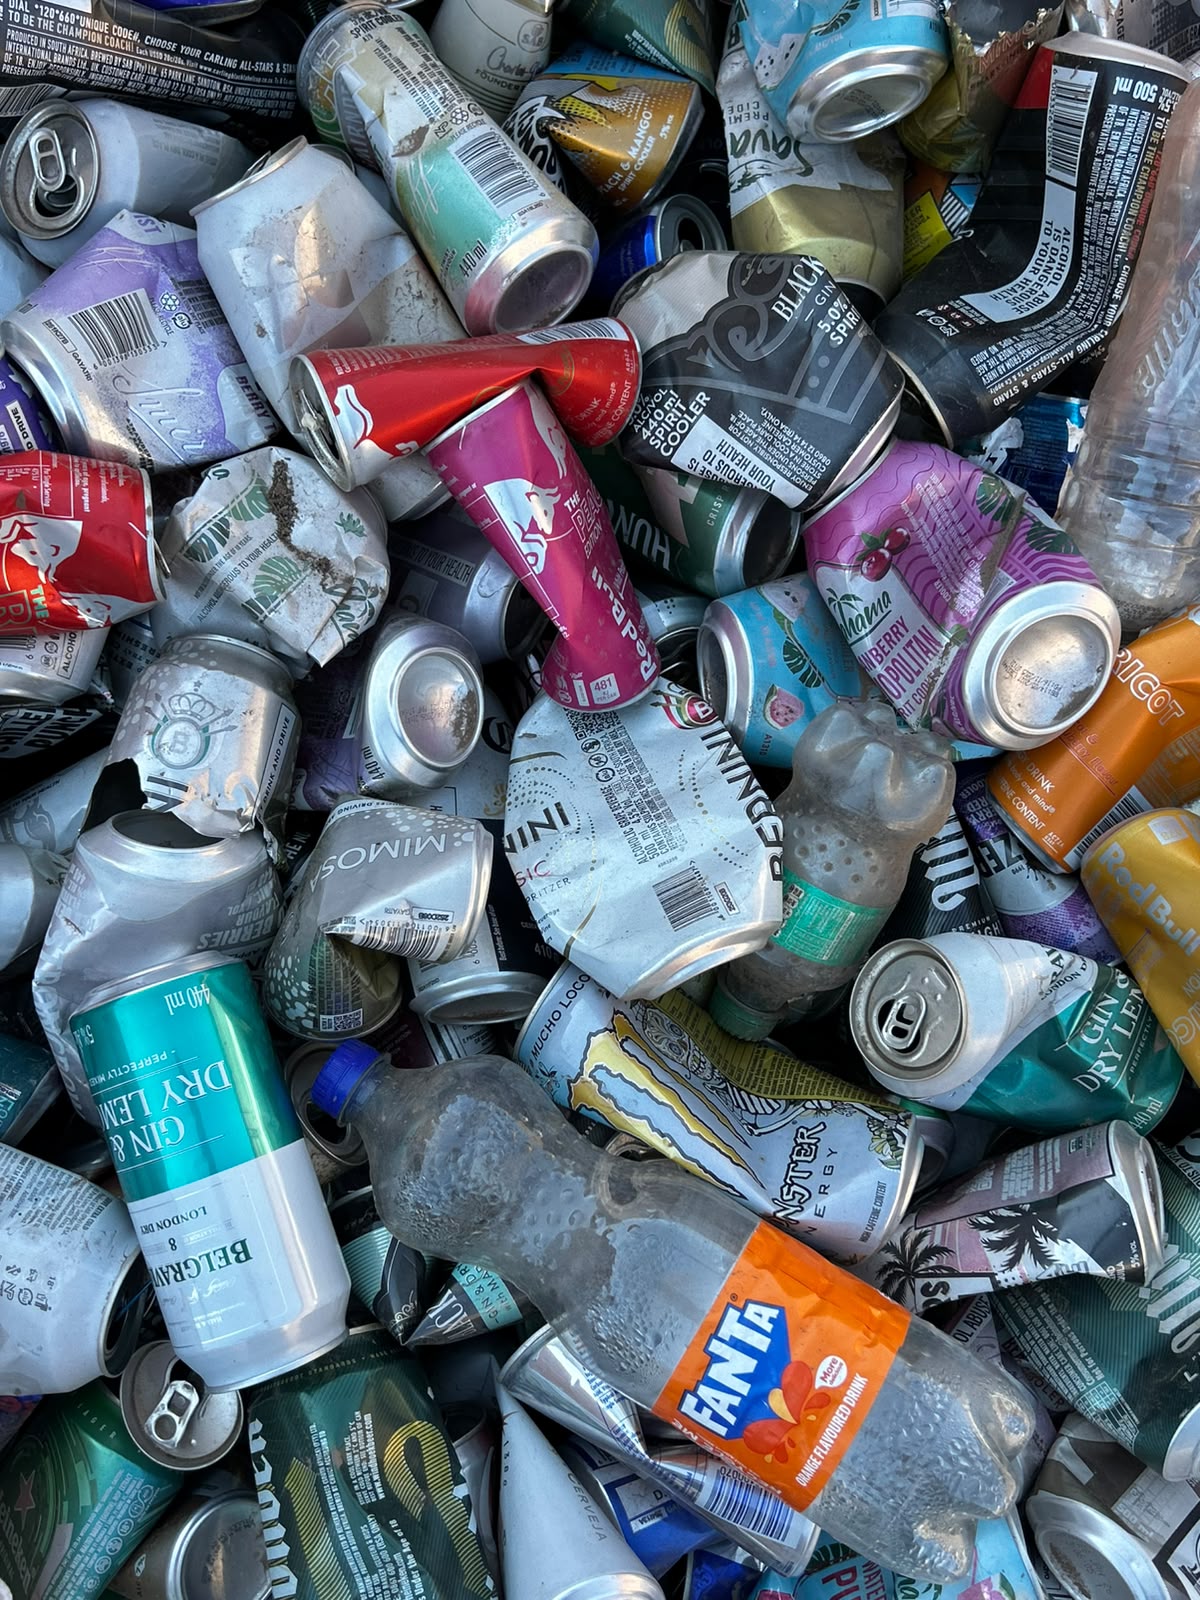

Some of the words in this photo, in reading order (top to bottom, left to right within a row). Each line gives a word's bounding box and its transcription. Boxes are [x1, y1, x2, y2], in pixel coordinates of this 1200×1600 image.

[7, 29, 38, 46] PRODUCED
[8, 10, 20, 22] TO
[23, 13, 35, 26] BE
[37, 17, 54, 32] THE
[57, 23, 102, 44] CHAMPION
[104, 36, 134, 52] COACH!
[350, 20, 378, 39] SPIRIT
[5, 41, 52, 61] INTERNATIONAL
[144, 35, 178, 52] CHOOSE
[180, 45, 202, 58] YOUR
[203, 52, 238, 69] CARLING
[240, 60, 274, 73] ALL-STARS
[1112, 76, 1133, 95] ml
[1132, 80, 1158, 103] 500
[728, 100, 760, 112] CIDE
[728, 110, 770, 126] PREMI
[627, 110, 653, 159] MANGO
[1115, 107, 1141, 157] INTERNATIONAL
[1132, 110, 1151, 145] PRODUCED
[1150, 130, 1160, 144] BE
[1154, 116, 1166, 129] TO
[618, 171, 637, 192] SPIRIT
[634, 135, 656, 171] COOLER
[1144, 146, 1157, 165] THE
[1127, 166, 1151, 216] CHAMPION
[1043, 220, 1054, 237] TO
[1052, 229, 1062, 244] IS
[1116, 217, 1136, 252] COACH!
[459, 250, 477, 278] 440
[475, 238, 488, 260] ml
[1028, 241, 1051, 274] YOUR
[1051, 226, 1072, 287] ALCOHOL
[770, 255, 828, 323] BLACK
[990, 277, 1031, 302] HEALTH
[1004, 245, 1060, 307] DANGEROUS
[1111, 264, 1131, 301] CHOOSE
[814, 280, 837, 306] GIN
[1011, 291, 1051, 316] ABUSE
[816, 298, 849, 333] 5.0%
[1103, 303, 1119, 327] YOUR
[71, 351, 93, 382] GAYATRI
[1031, 349, 1075, 383] ALL-STARS
[235, 375, 270, 420] BERRY
[993, 385, 1020, 407] STAND
[1020, 379, 1030, 388] &
[611, 379, 632, 422] CONTENT
[633, 388, 668, 433] ALC/VOL
[641, 408, 665, 441] 440
[663, 389, 679, 412] ml
[10, 405, 30, 439] DRIVE
[649, 398, 687, 450] SPIRIT
[660, 391, 711, 457] COOLER
[728, 423, 741, 437] FOR
[734, 420, 746, 431] OF
[744, 428, 759, 440] AGE
[755, 425, 774, 441] DARK
[760, 418, 792, 447] CARELINE
[779, 421, 797, 438] (RSA
[715, 438, 752, 473] HEALTH
[739, 434, 757, 449] NOT
[755, 439, 769, 450] THE
[767, 448, 790, 466] UNDER
[772, 438, 790, 455] COOL
[687, 457, 700, 472] IS
[702, 448, 719, 467] TO
[790, 442, 827, 473] CUSTOMER
[799, 461, 822, 479] STORE
[813, 449, 832, 467] 0860
[749, 463, 777, 493] YOUR
[787, 463, 817, 486] PERSONS
[790, 474, 813, 491] ENJOY
[563, 489, 582, 513] THE
[570, 486, 603, 544] PEAC
[606, 499, 672, 571] HUN
[246, 547, 263, 564] YOUR
[443, 559, 474, 583] HEALTH
[30, 585, 49, 620] THE
[61, 630, 78, 673] ALCOHO
[620, 617, 658, 682] Red
[858, 615, 909, 673] NBERRY
[875, 624, 944, 702] OPOLITAN
[593, 677, 614, 692] 481
[1113, 647, 1186, 727] RICOT
[898, 699, 916, 721] RIT
[272, 751, 283, 772] AND
[278, 716, 291, 749] DRIVE
[361, 745, 375, 761] ml
[367, 758, 386, 781] 440
[1026, 761, 1055, 793] DRINK
[1020, 780, 1036, 796] and
[1012, 796, 1047, 831] CONTENT
[623, 827, 649, 865] ALCOHOLIC
[643, 843, 660, 861] 500
[647, 822, 670, 855] CONTAINS
[309, 832, 447, 893] MIMOSA
[526, 876, 572, 904] PRITZER
[1099, 841, 1156, 905] Red
[1148, 894, 1200, 957] Bull
[197, 914, 274, 950] BERRIES
[163, 992, 187, 1016] ml
[189, 982, 211, 1009] 440
[1079, 991, 1121, 1045] GIN
[1114, 968, 1130, 990] &
[530, 1008, 563, 1060] MUCHO
[562, 972, 593, 1011] LOCO
[1072, 1038, 1124, 1093] DRY
[1111, 987, 1145, 1039] LEM
[105, 1052, 169, 1083] PERFECTLY
[161, 1059, 233, 1112] DRY
[98, 1088, 153, 1132] LEM
[1128, 1106, 1151, 1130] 440
[1147, 1095, 1164, 1115] ml
[109, 1135, 126, 1162] &
[131, 1116, 186, 1159] GIN
[774, 1121, 826, 1226] NSTER
[803, 1145, 841, 1238] NERGY
[873, 1180, 887, 1209] CONTENT
[138, 1220, 157, 1237] DRY
[157, 1204, 209, 1232] LONDON
[864, 1201, 882, 1233] CAFFEINE
[859, 1226, 873, 1244] HIGH
[148, 1237, 254, 1290] BELGRAV
[680, 1300, 781, 1438] FANTA
[819, 1356, 839, 1385] More
[795, 1443, 825, 1488] ORANGE
[815, 1404, 851, 1462] FLAVOURED
[845, 1373, 869, 1414] DRINK
[566, 1471, 609, 1543] CERVEJA
[1, 1504, 32, 1592] eineken
